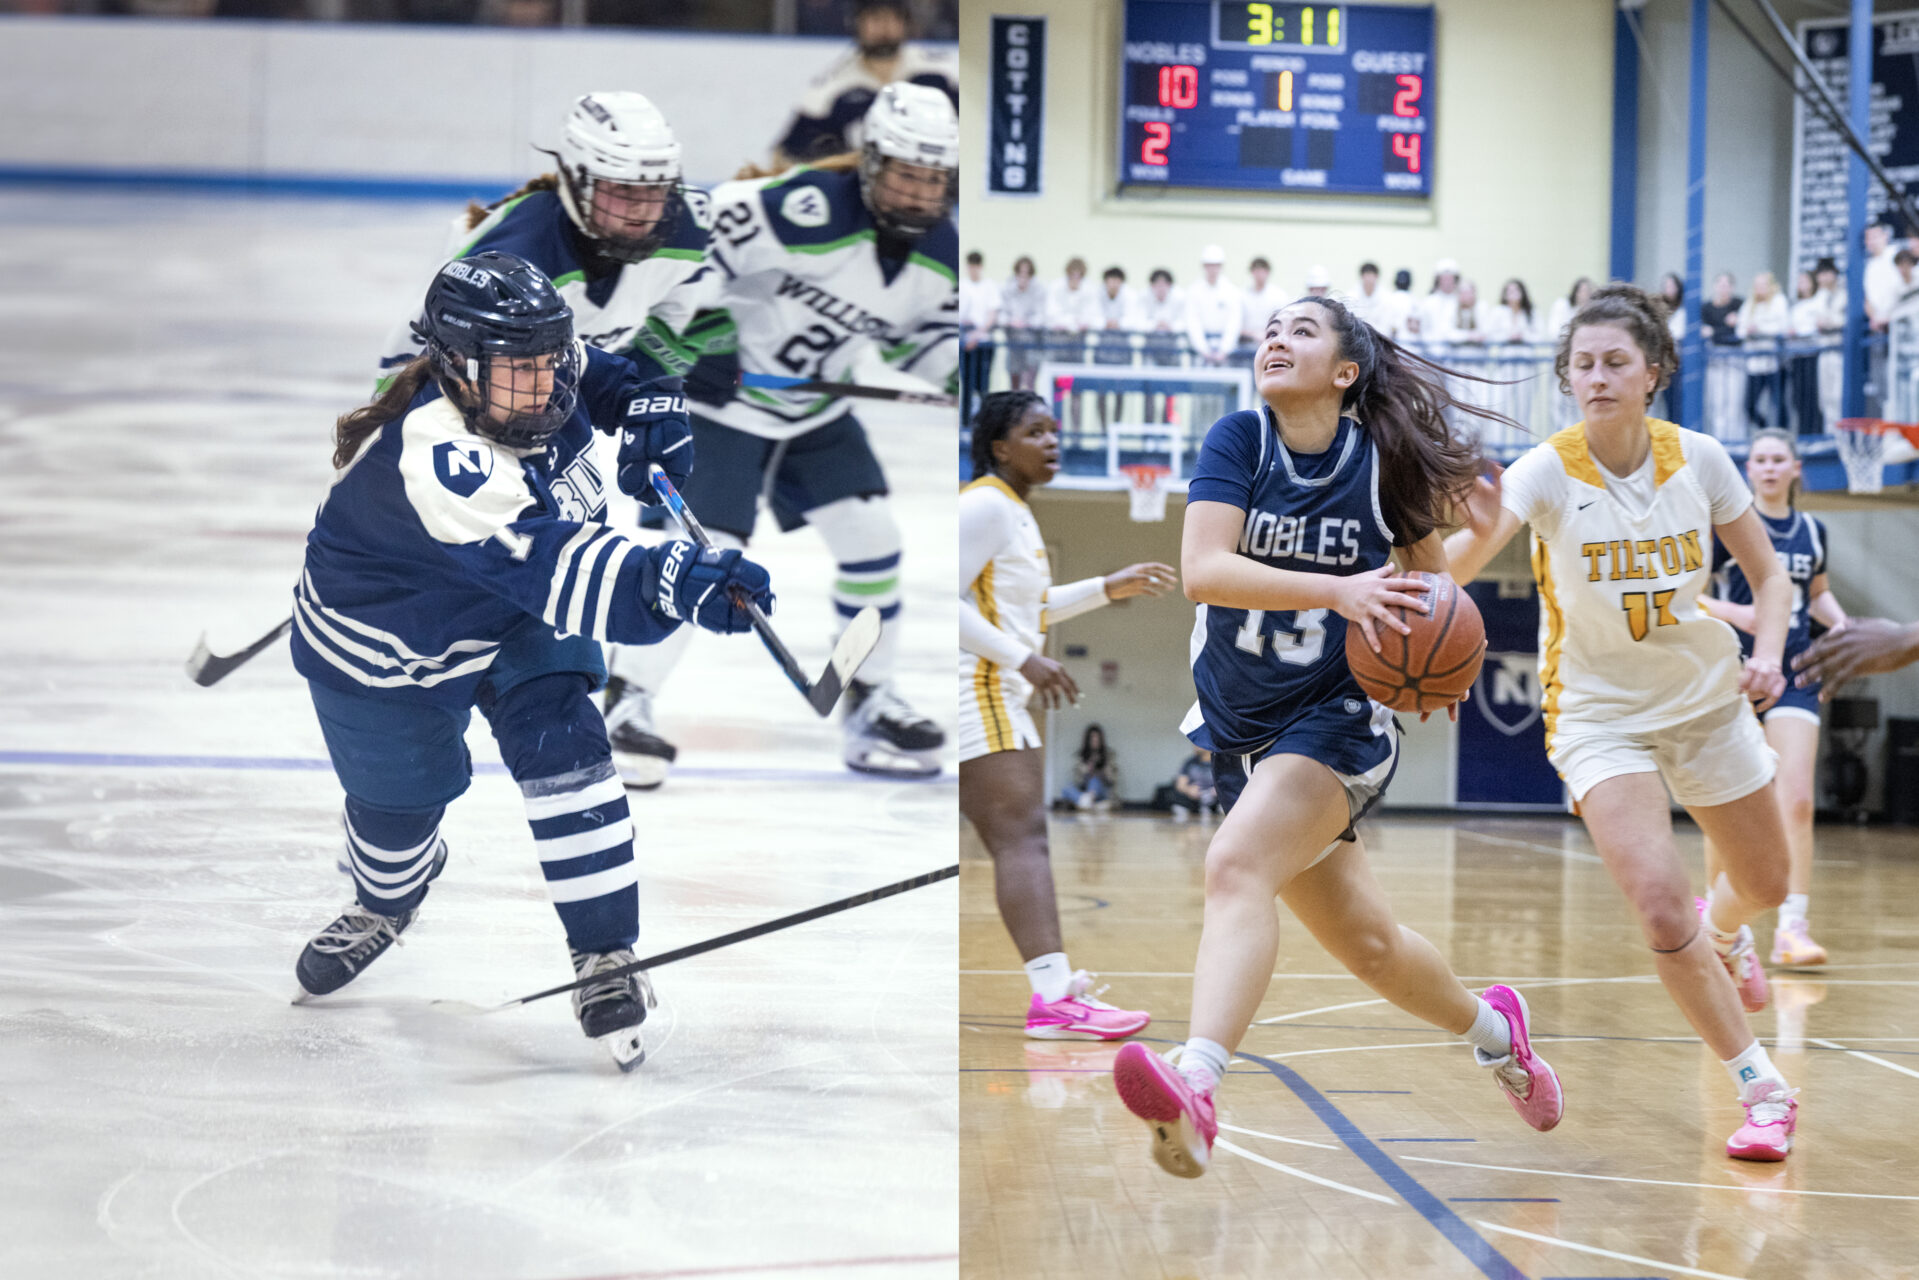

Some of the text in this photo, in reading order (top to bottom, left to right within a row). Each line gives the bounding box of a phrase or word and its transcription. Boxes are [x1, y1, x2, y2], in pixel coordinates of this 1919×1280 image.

[1247, 3, 1340, 46] 3:11
[1126, 42, 1206, 65] NOBLES
[1352, 50, 1425, 73] GUEST
[1004, 23, 1030, 189] COTTING
[1159, 65, 1198, 109] 10
[1278, 70, 1293, 111] 1
[1393, 74, 1422, 117] 2
[1141, 121, 1170, 165] 2
[1392, 133, 1421, 173] 4
[716, 202, 760, 248] 21
[442, 262, 492, 289] NOBLES
[627, 396, 690, 416] BAU
[1582, 529, 1704, 582] TILTON
[1235, 607, 1329, 667] 13
